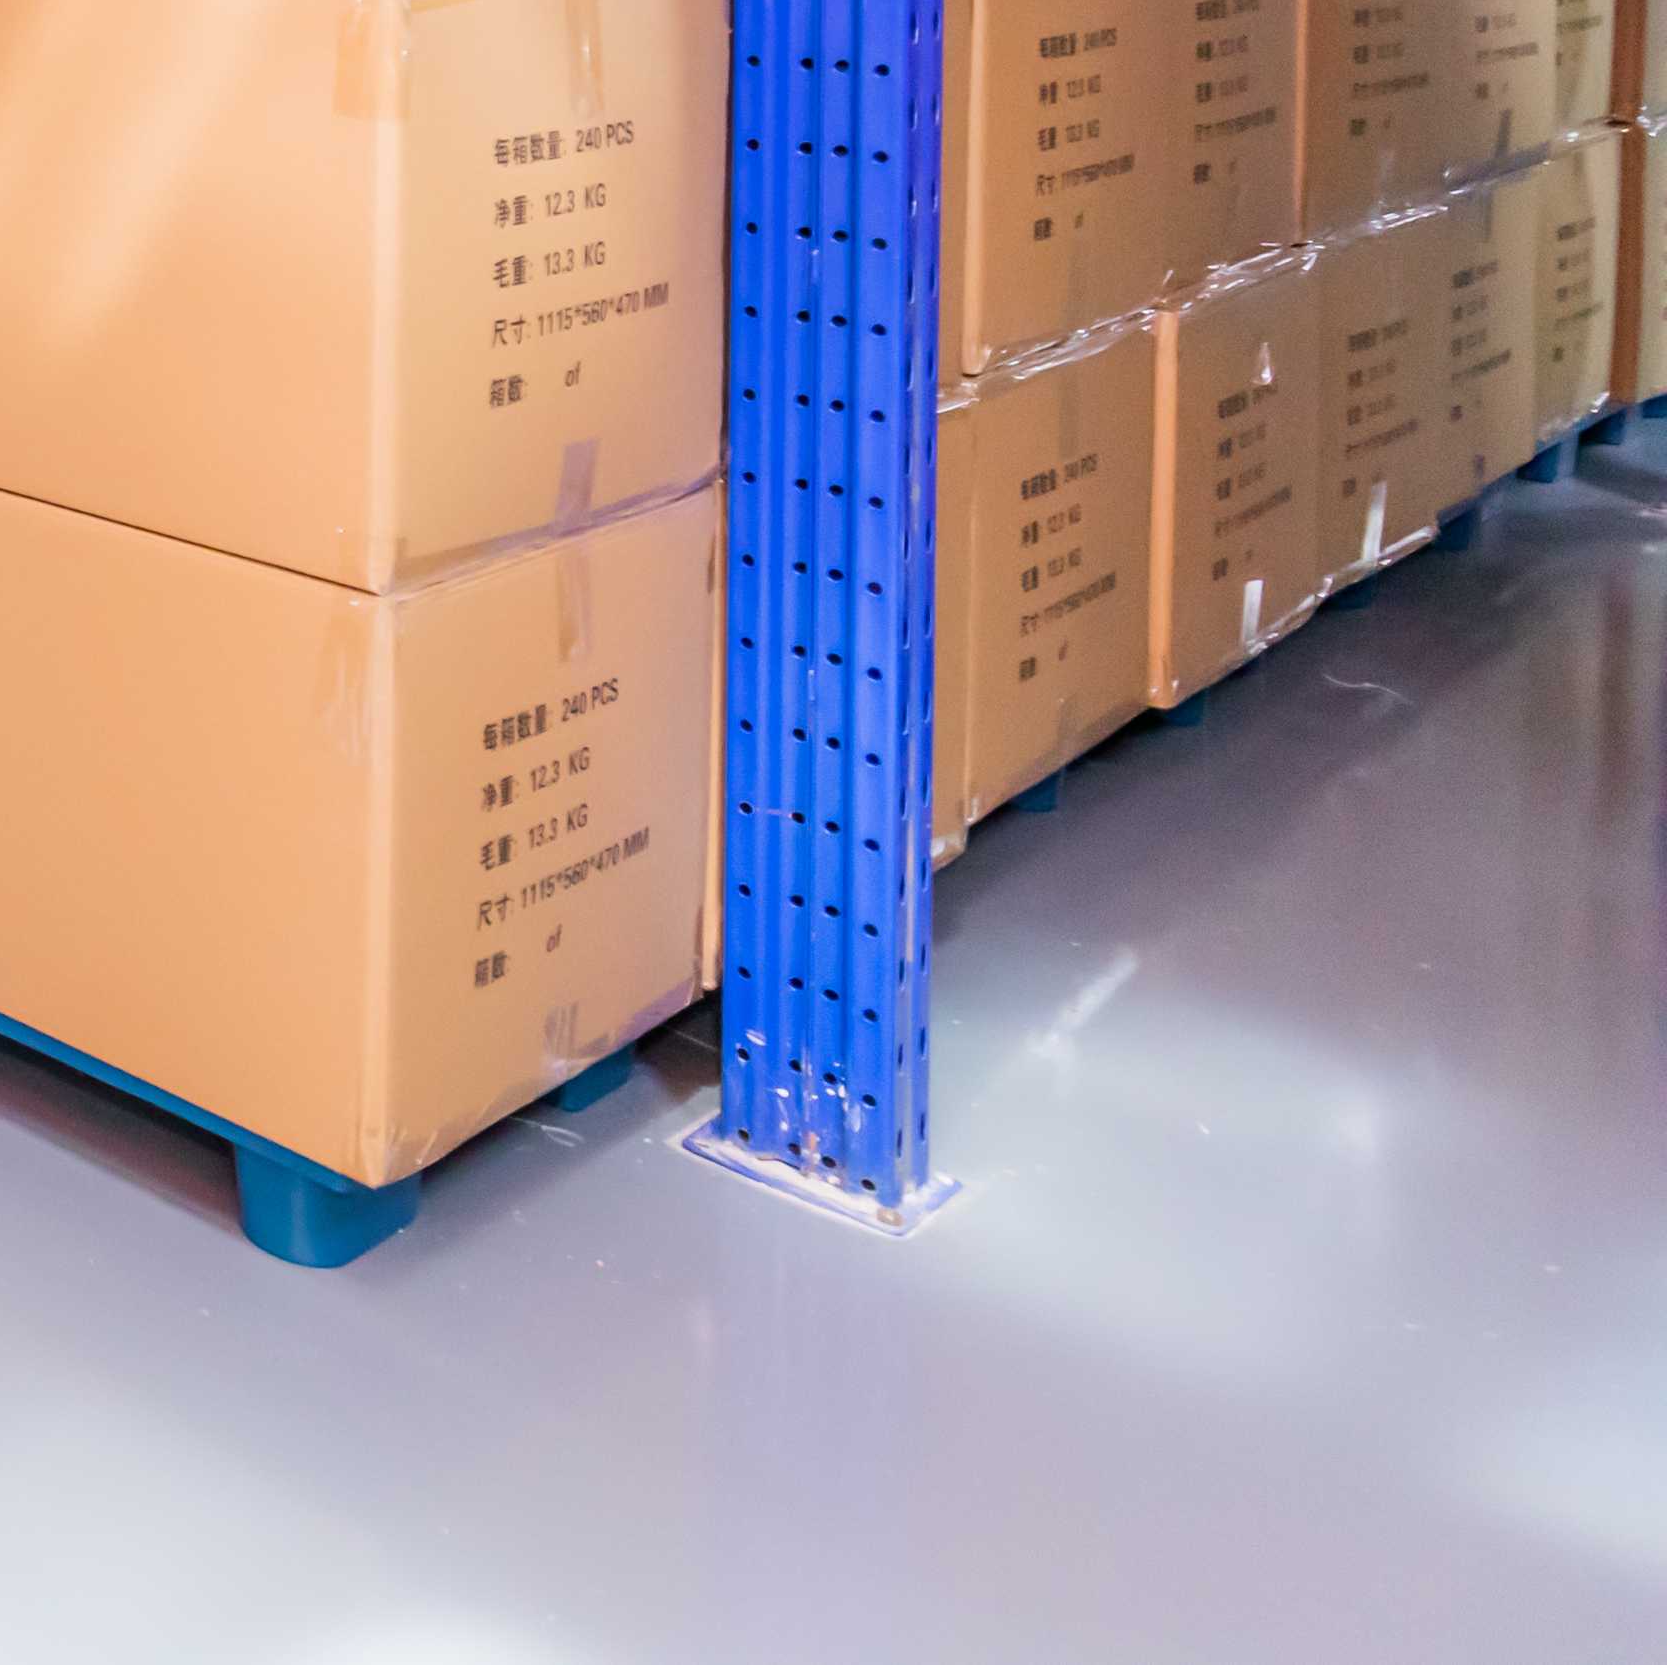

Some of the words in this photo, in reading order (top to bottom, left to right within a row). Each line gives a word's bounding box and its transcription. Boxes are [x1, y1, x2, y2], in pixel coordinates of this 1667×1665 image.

[575, 126, 602, 153] 240
[606, 120, 635, 147] PCS
[545, 189, 576, 217] 12.3
[584, 183, 606, 209] KG
[544, 248, 575, 276] 13.3
[583, 241, 606, 268] KG
[643, 282, 669, 310] MM
[564, 360, 581, 387] of
[561, 691, 587, 722] 240
[591, 678, 619, 710] PCS
[529, 760, 560, 793] 12.3
[568, 746, 591, 775] KG
[529, 817, 558, 849] 13.3
[566, 803, 588, 833] KG
[623, 826, 650, 860] MM
[546, 923, 562, 953] of
